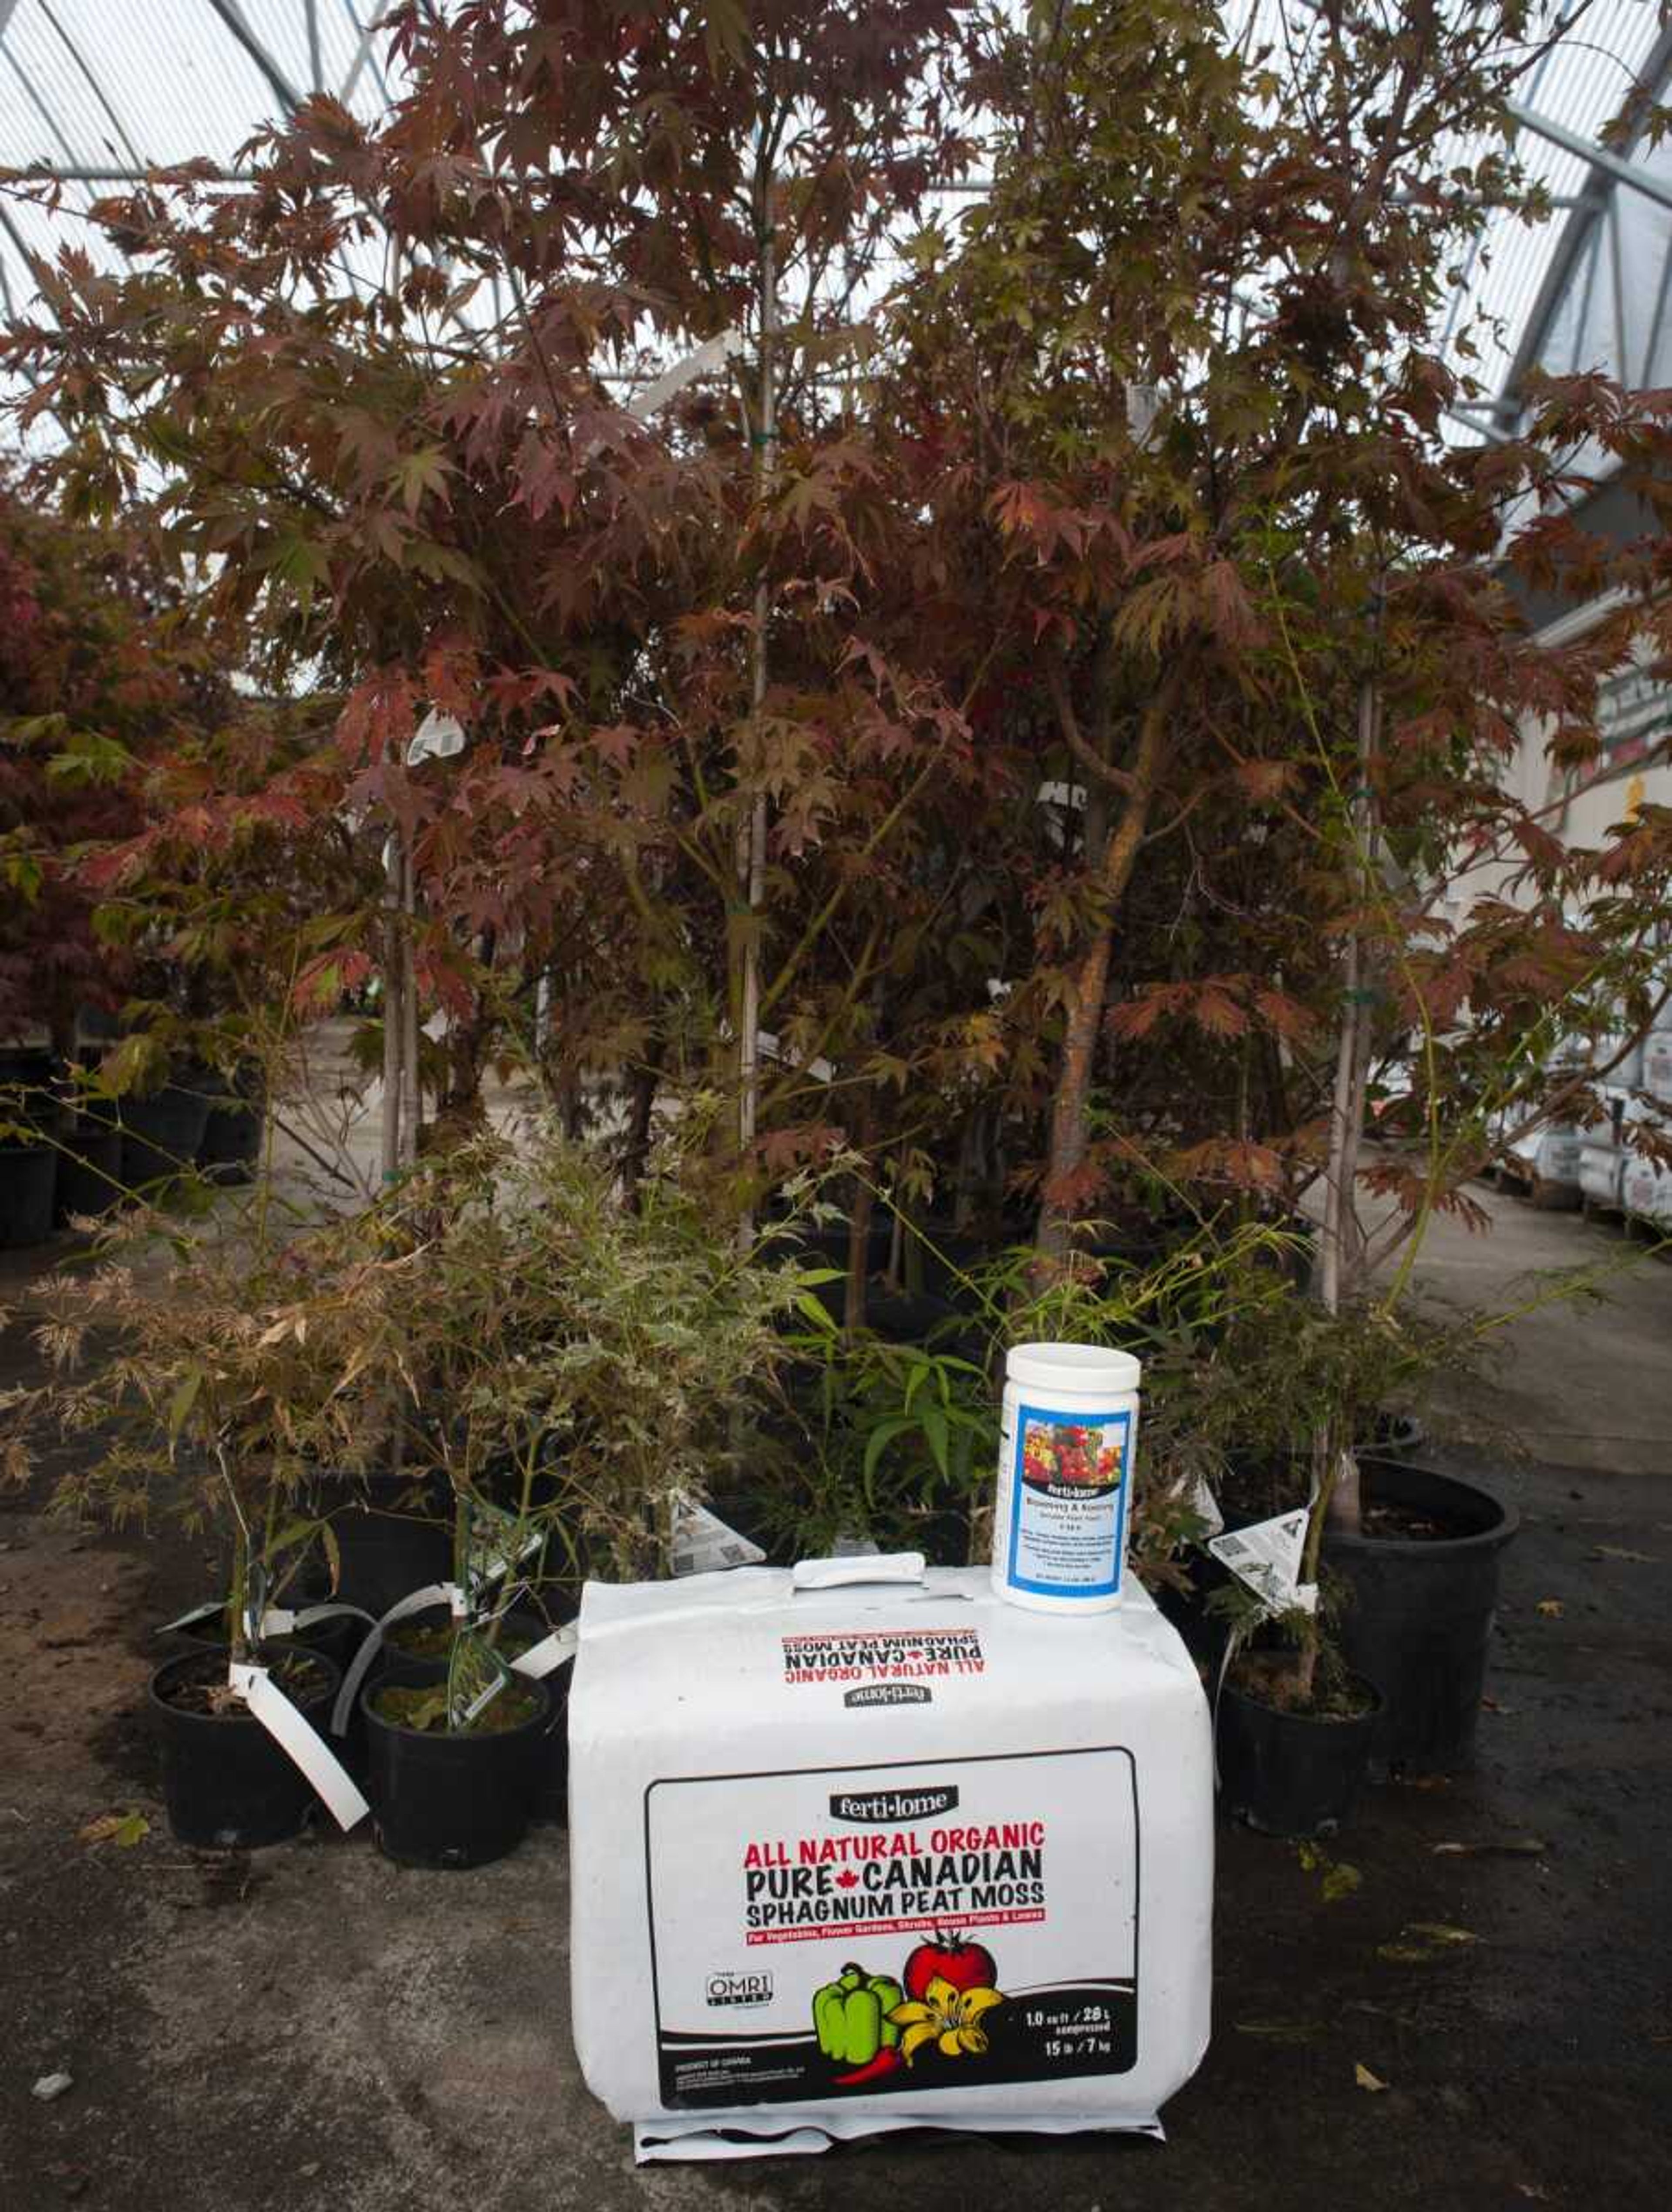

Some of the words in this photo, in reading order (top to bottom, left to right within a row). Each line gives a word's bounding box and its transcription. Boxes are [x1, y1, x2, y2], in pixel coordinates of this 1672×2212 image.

[839, 1640, 878, 1650] PEAT
[883, 1635, 978, 1648] SPHAGNUM
[785, 1649, 905, 1669] CANADIAN
[924, 1644, 982, 1661] PURE
[868, 1662, 950, 1678] NATURAL
[956, 1659, 985, 1673] ALL
[785, 1667, 862, 1683] ORGANIC
[744, 1842, 792, 1868] ALL
[799, 1831, 924, 1864] NATURAL
[930, 1821, 1044, 1853] ORGANIC
[746, 1864, 834, 1902] PURE
[863, 1848, 1042, 1892] CANADIAN
[746, 1894, 894, 1927] SPHAGNUM
[901, 1888, 963, 1915] PEAT
[971, 1881, 1044, 1909] MOSS
[710, 1976, 768, 1996] OMRI
[1026, 2010, 1043, 2027] 1.0
[1046, 2040, 1061, 2057] 15
[1088, 2037, 1096, 2054] 7
